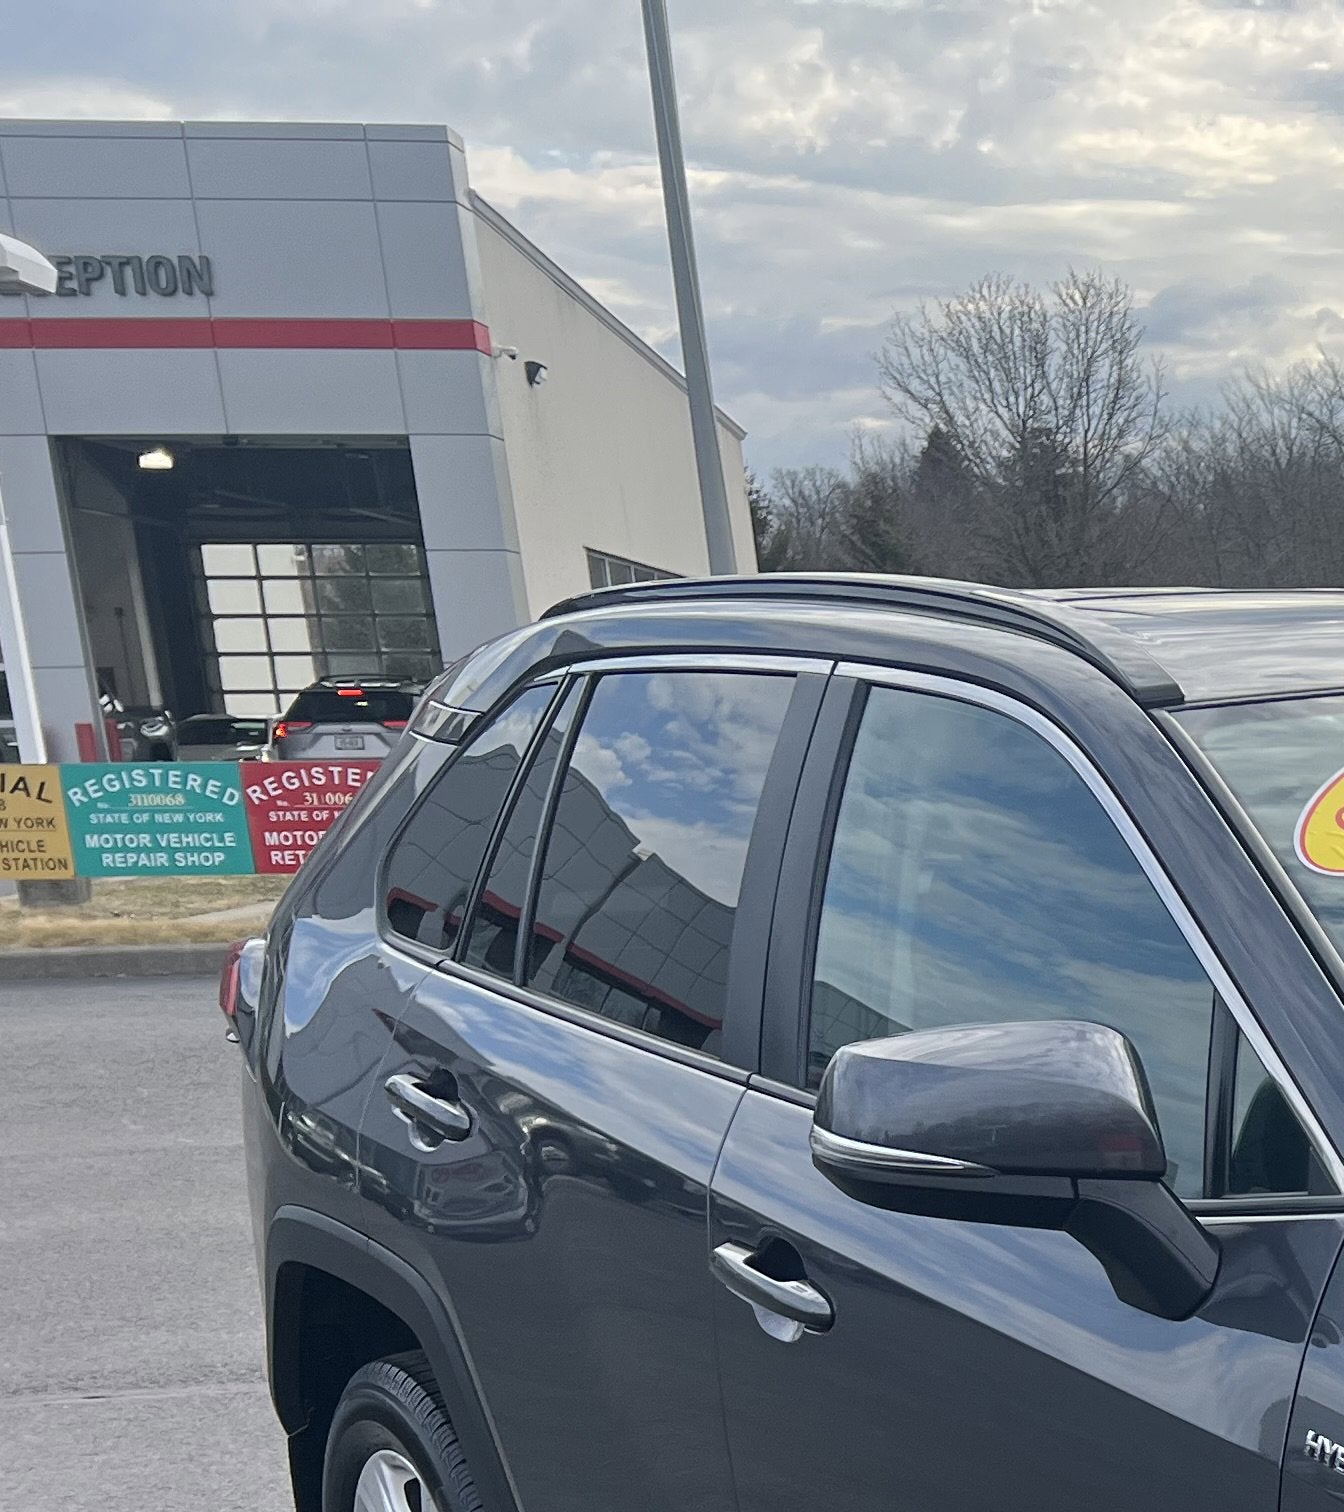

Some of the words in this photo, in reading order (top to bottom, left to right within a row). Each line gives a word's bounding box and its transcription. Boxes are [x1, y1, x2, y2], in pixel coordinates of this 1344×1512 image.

[46, 255, 214, 297] EPTION
[67, 768, 240, 808] REGISTERED
[14, 817, 56, 829] YORK
[89, 813, 129, 825] STATE
[133, 813, 150, 823] OF
[154, 812, 184, 823] NEW
[187, 811, 225, 823] YORK
[269, 811, 309, 822] STATE
[312, 811, 330, 822] OF
[85, 834, 153, 849] MOTOR
[156, 832, 237, 848] VEHICLE
[2, 857, 68, 872] STATION
[102, 852, 169, 868] REPAIR
[174, 851, 225, 867] SHOP
[270, 850, 310, 865] RET
